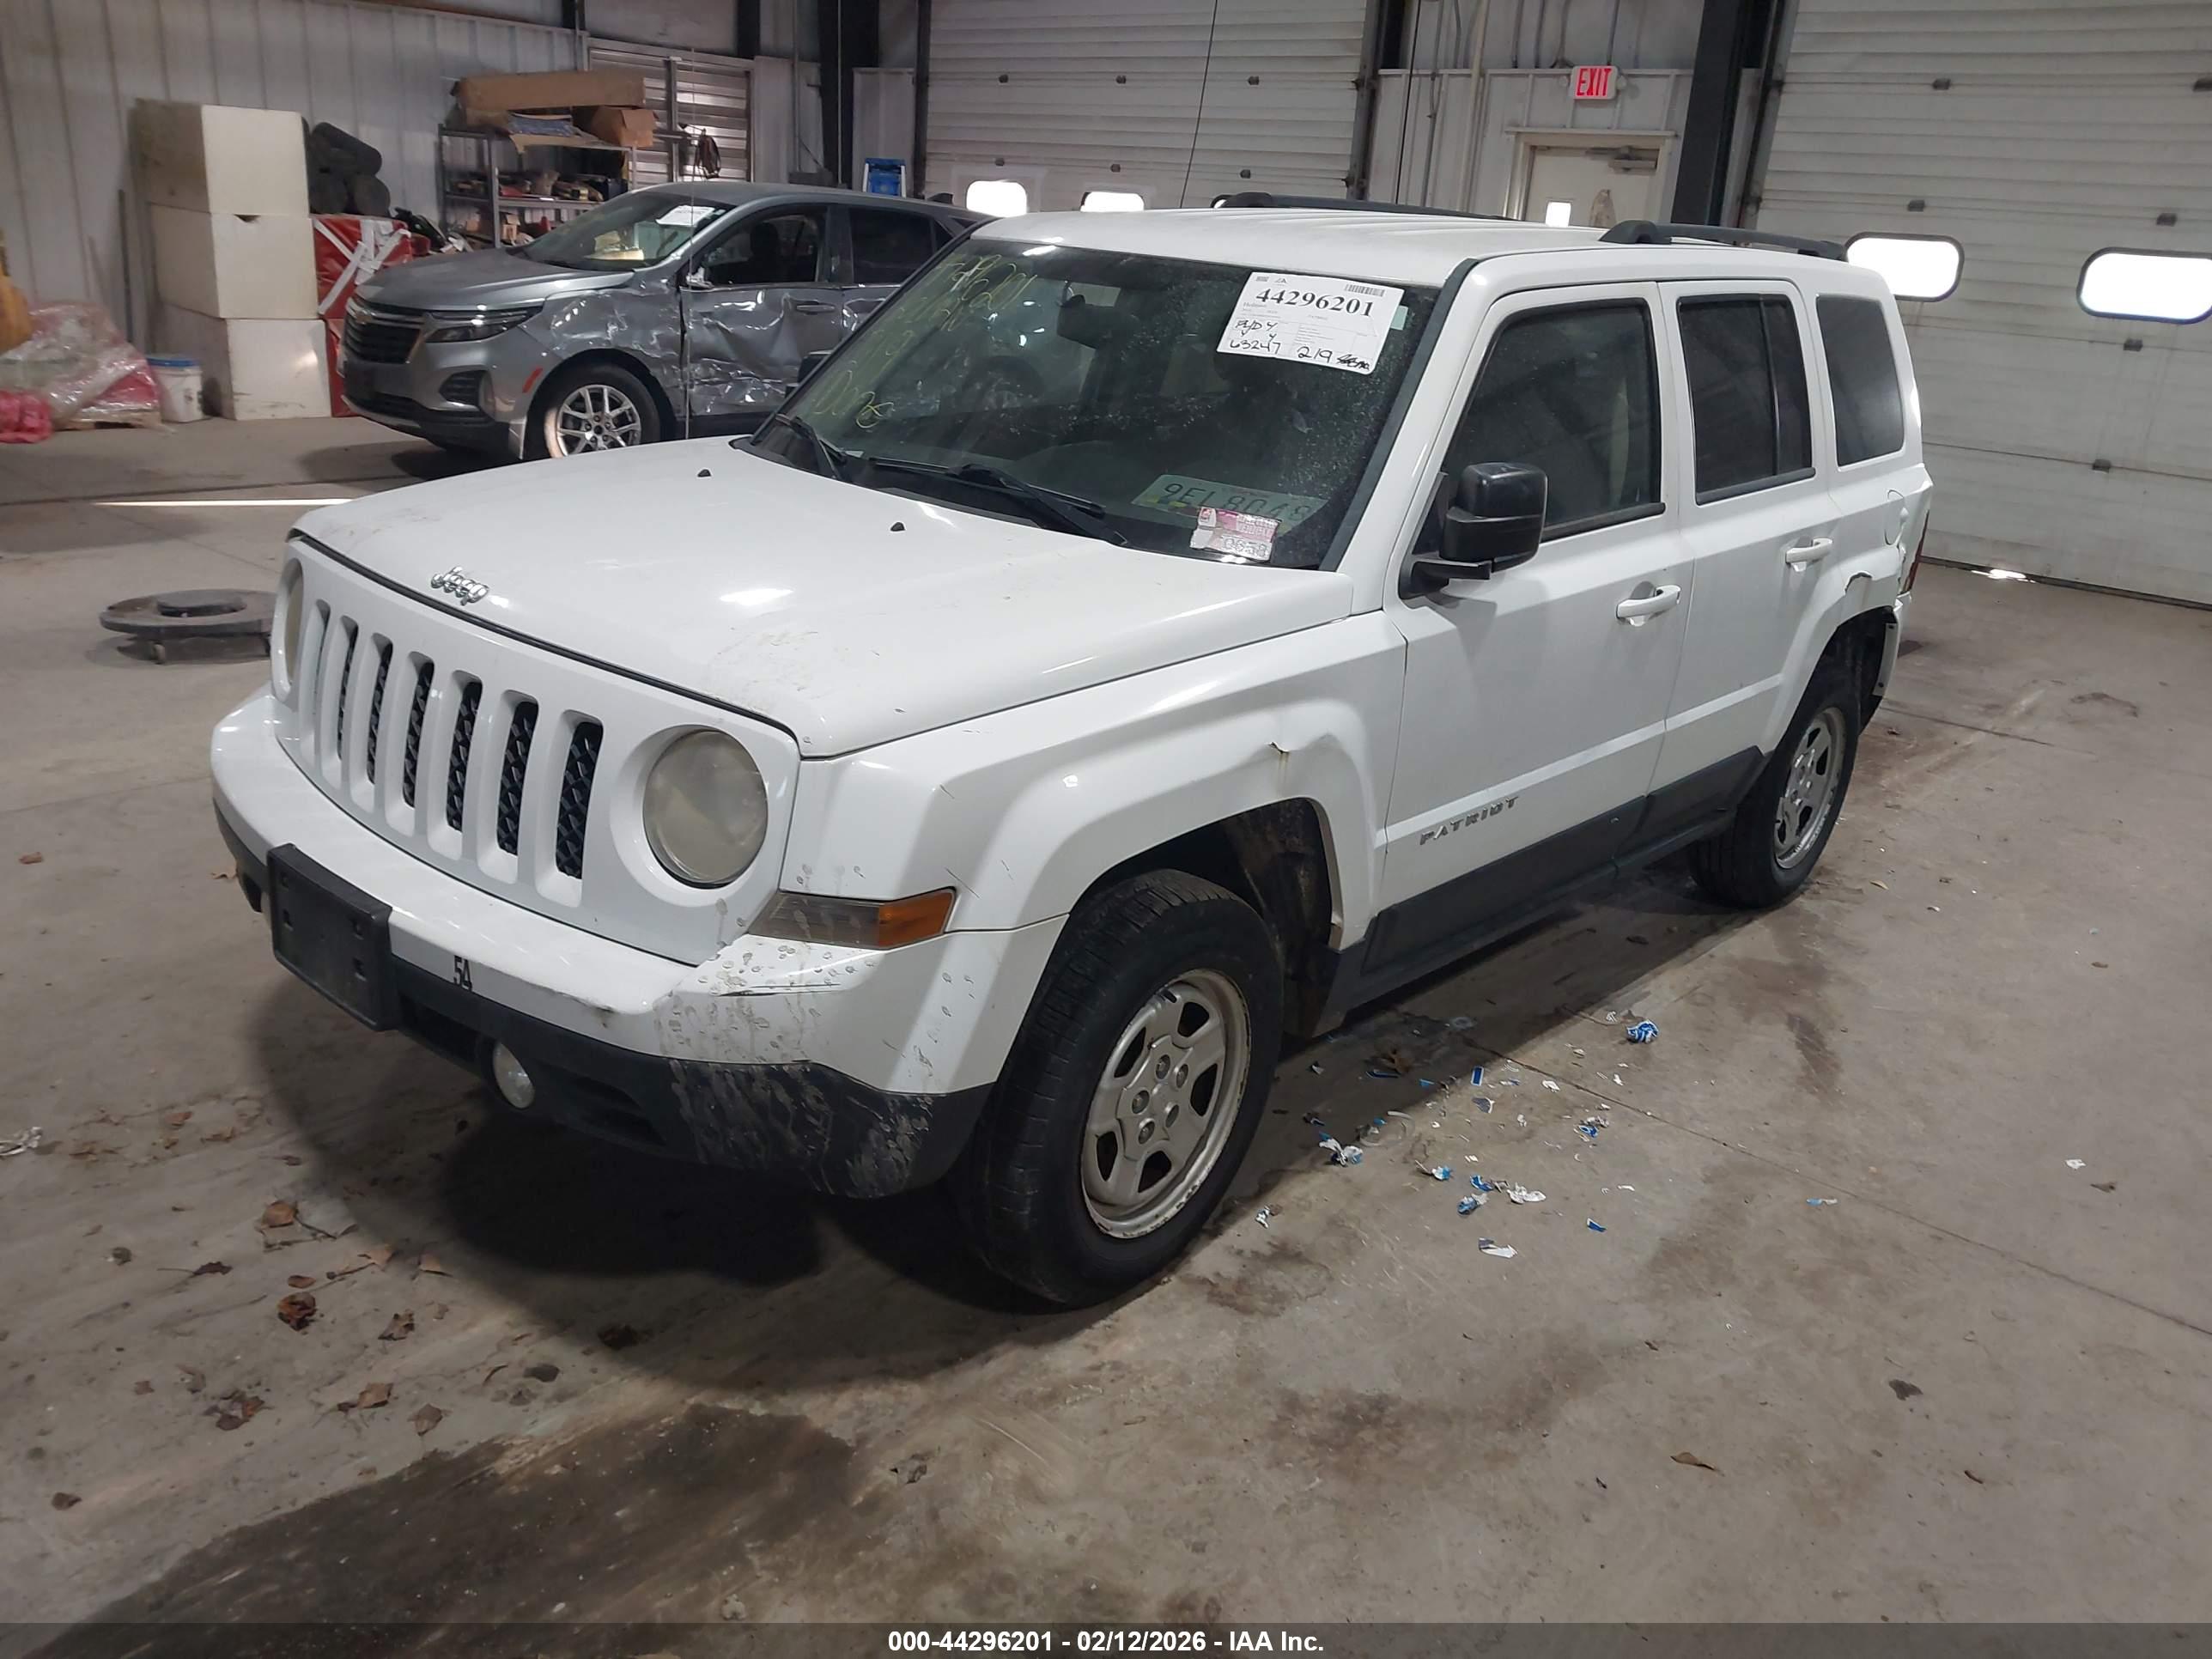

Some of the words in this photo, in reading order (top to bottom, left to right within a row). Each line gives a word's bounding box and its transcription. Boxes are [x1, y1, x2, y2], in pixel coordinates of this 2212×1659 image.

[1577, 68, 1612, 96] EXIT
[1255, 288, 1374, 317] 44296201
[1419, 796, 1519, 846] PATRIOT
[453, 954, 472, 991] 54
